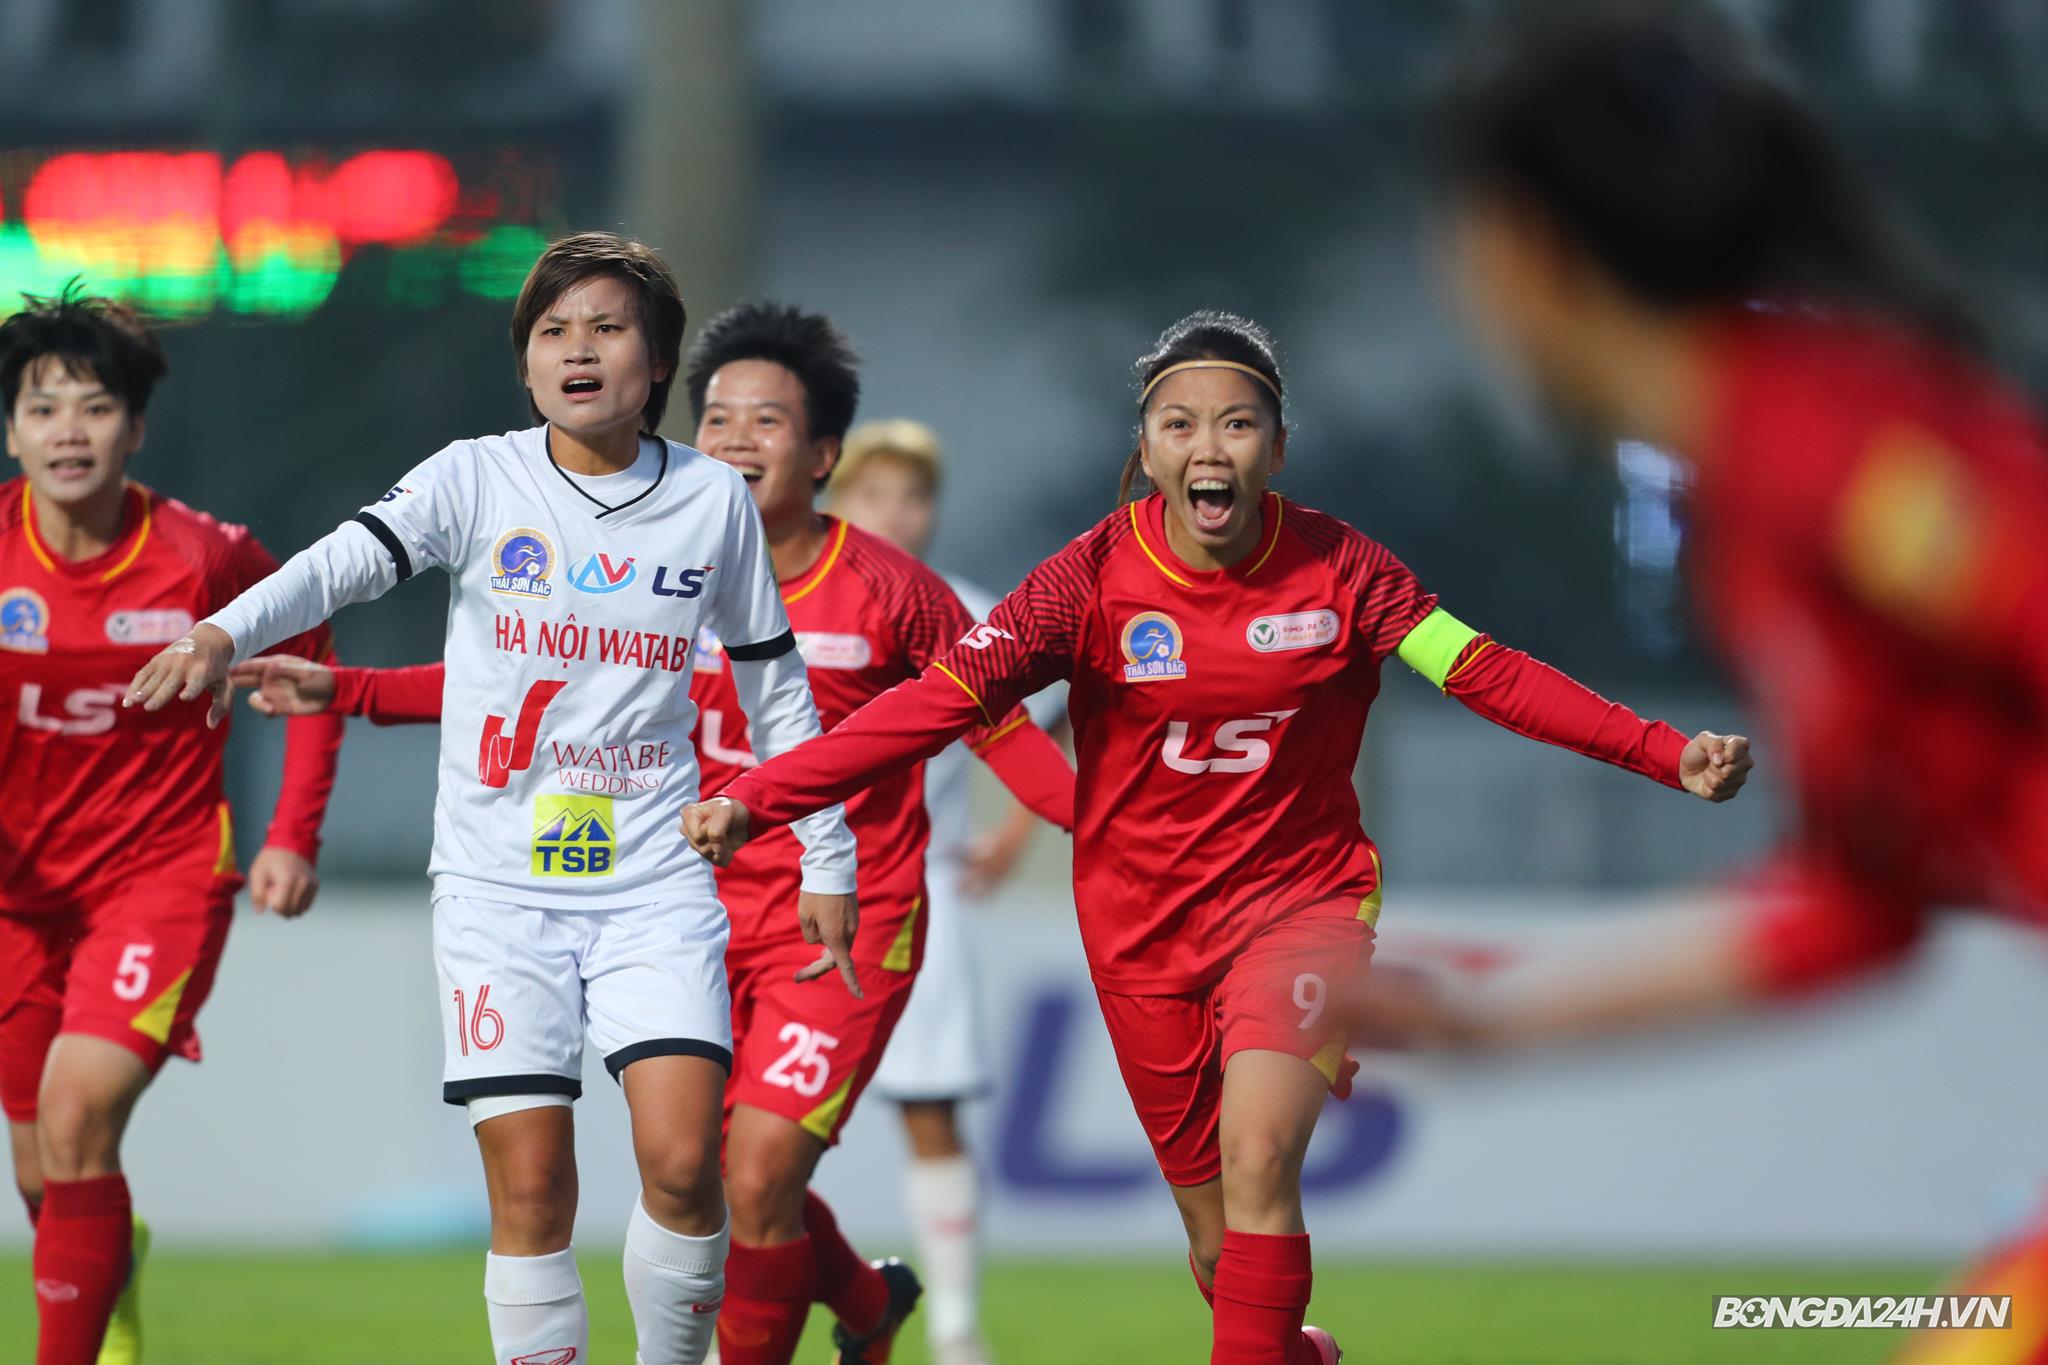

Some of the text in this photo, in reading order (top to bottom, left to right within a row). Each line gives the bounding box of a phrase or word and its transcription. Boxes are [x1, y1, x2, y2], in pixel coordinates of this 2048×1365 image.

[652, 565, 706, 599] LS
[496, 609, 527, 654] HÀ
[537, 613, 589, 668] NỘI
[18, 683, 117, 735] LS
[552, 741, 669, 772] WATABE
[702, 709, 761, 769] L
[1162, 717, 1274, 775] LS
[560, 768, 660, 795] WEDDING
[536, 846, 611, 873] TSB
[112, 944, 154, 1000] 5
[453, 984, 505, 1057] 16
[1292, 973, 1327, 1029] 9
[763, 1022, 839, 1097] 25
